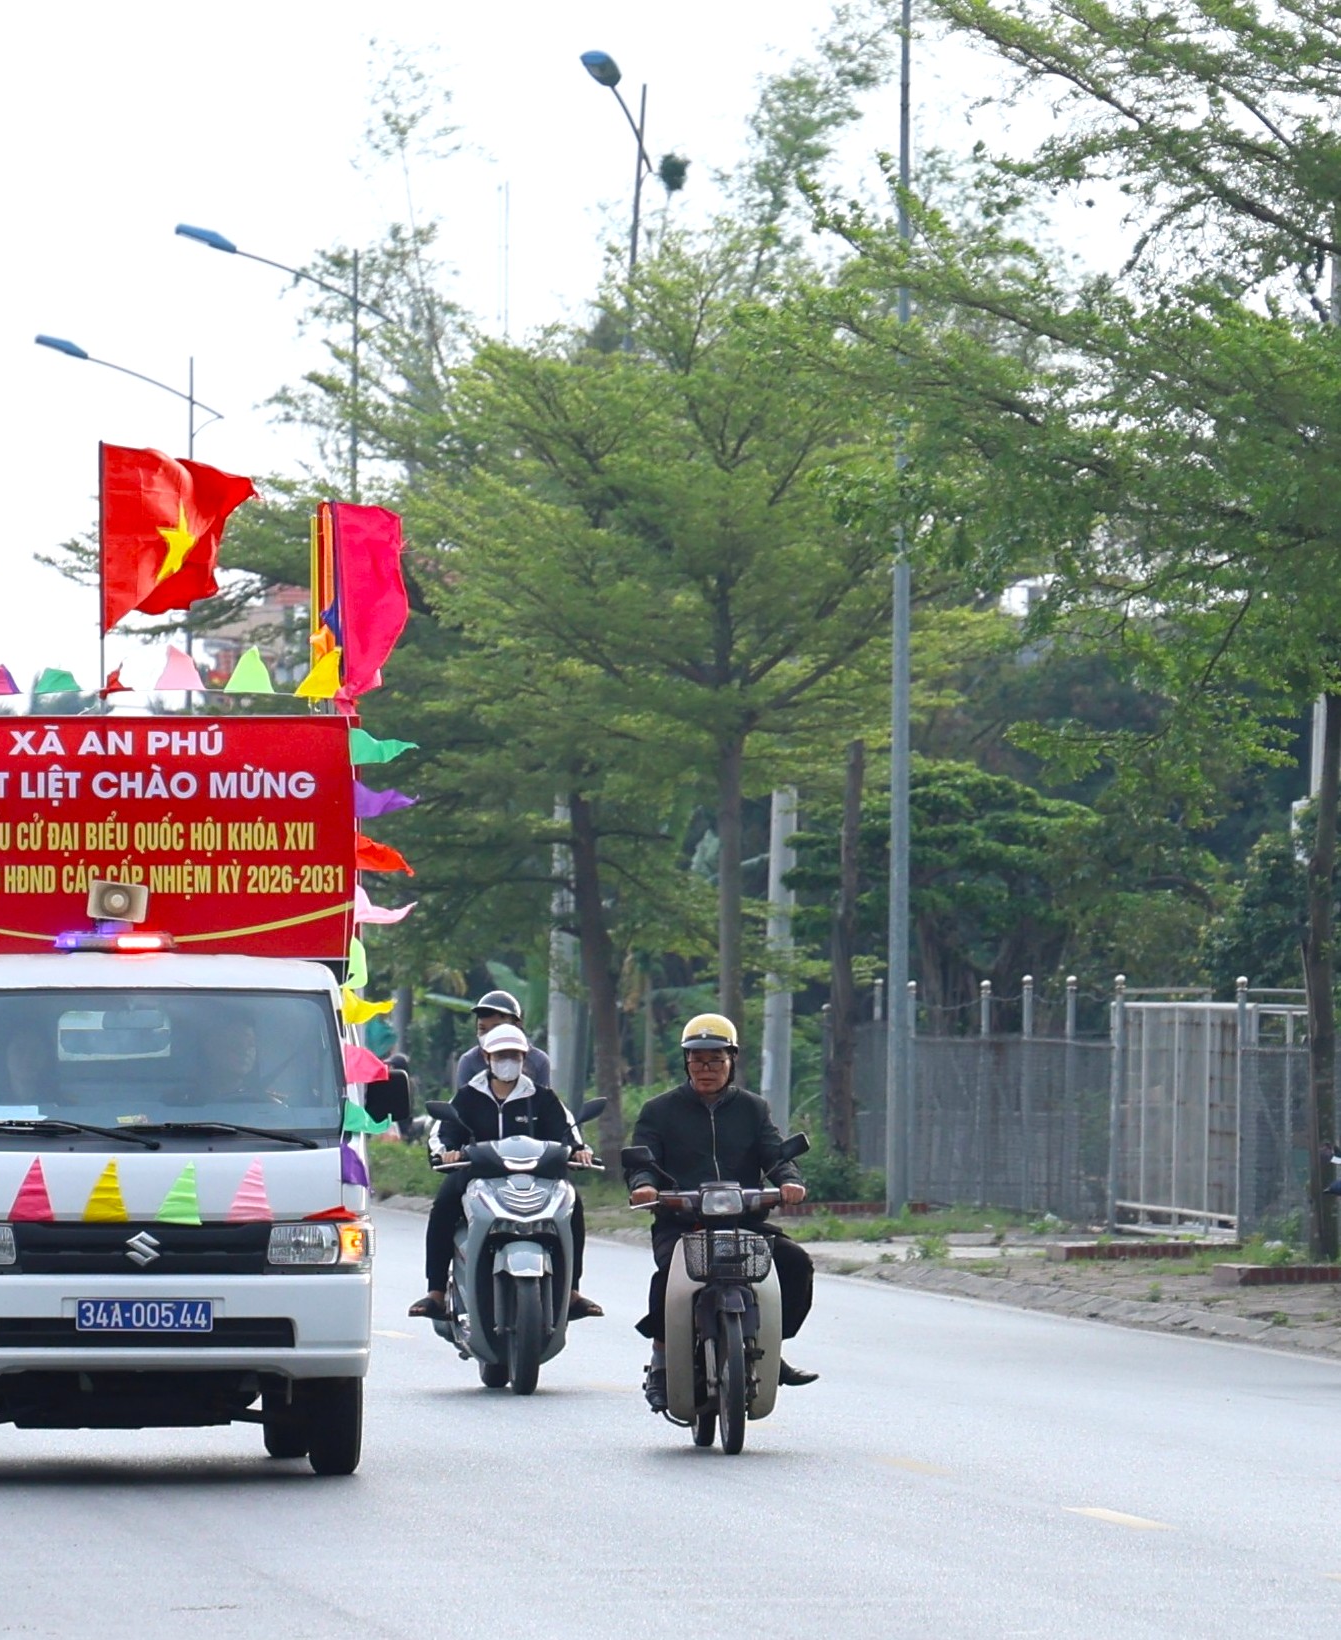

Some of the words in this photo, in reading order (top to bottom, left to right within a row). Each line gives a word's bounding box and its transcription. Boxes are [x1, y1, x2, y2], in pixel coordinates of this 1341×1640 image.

[8, 725, 66, 756] XÃ
[77, 731, 133, 756] AN
[147, 724, 224, 756] PHÚ
[21, 764, 82, 807] LIỆT
[91, 763, 198, 799] CHÀO
[209, 763, 316, 799] MỪNG
[16, 812, 44, 851] CỬ
[47, 822, 80, 857] ĐẠI
[85, 811, 129, 851] BIỂU
[134, 812, 185, 854] QUỐC
[190, 816, 222, 858] HỘI
[228, 816, 279, 851] KHÓA
[283, 822, 315, 851] XVI
[4, 865, 56, 894] HĐND
[149, 859, 212, 900] NHIỆM
[217, 858, 242, 894] KỲ
[247, 864, 345, 894] 2026-2031
[81, 1302, 208, 1328] 34A-005.44
